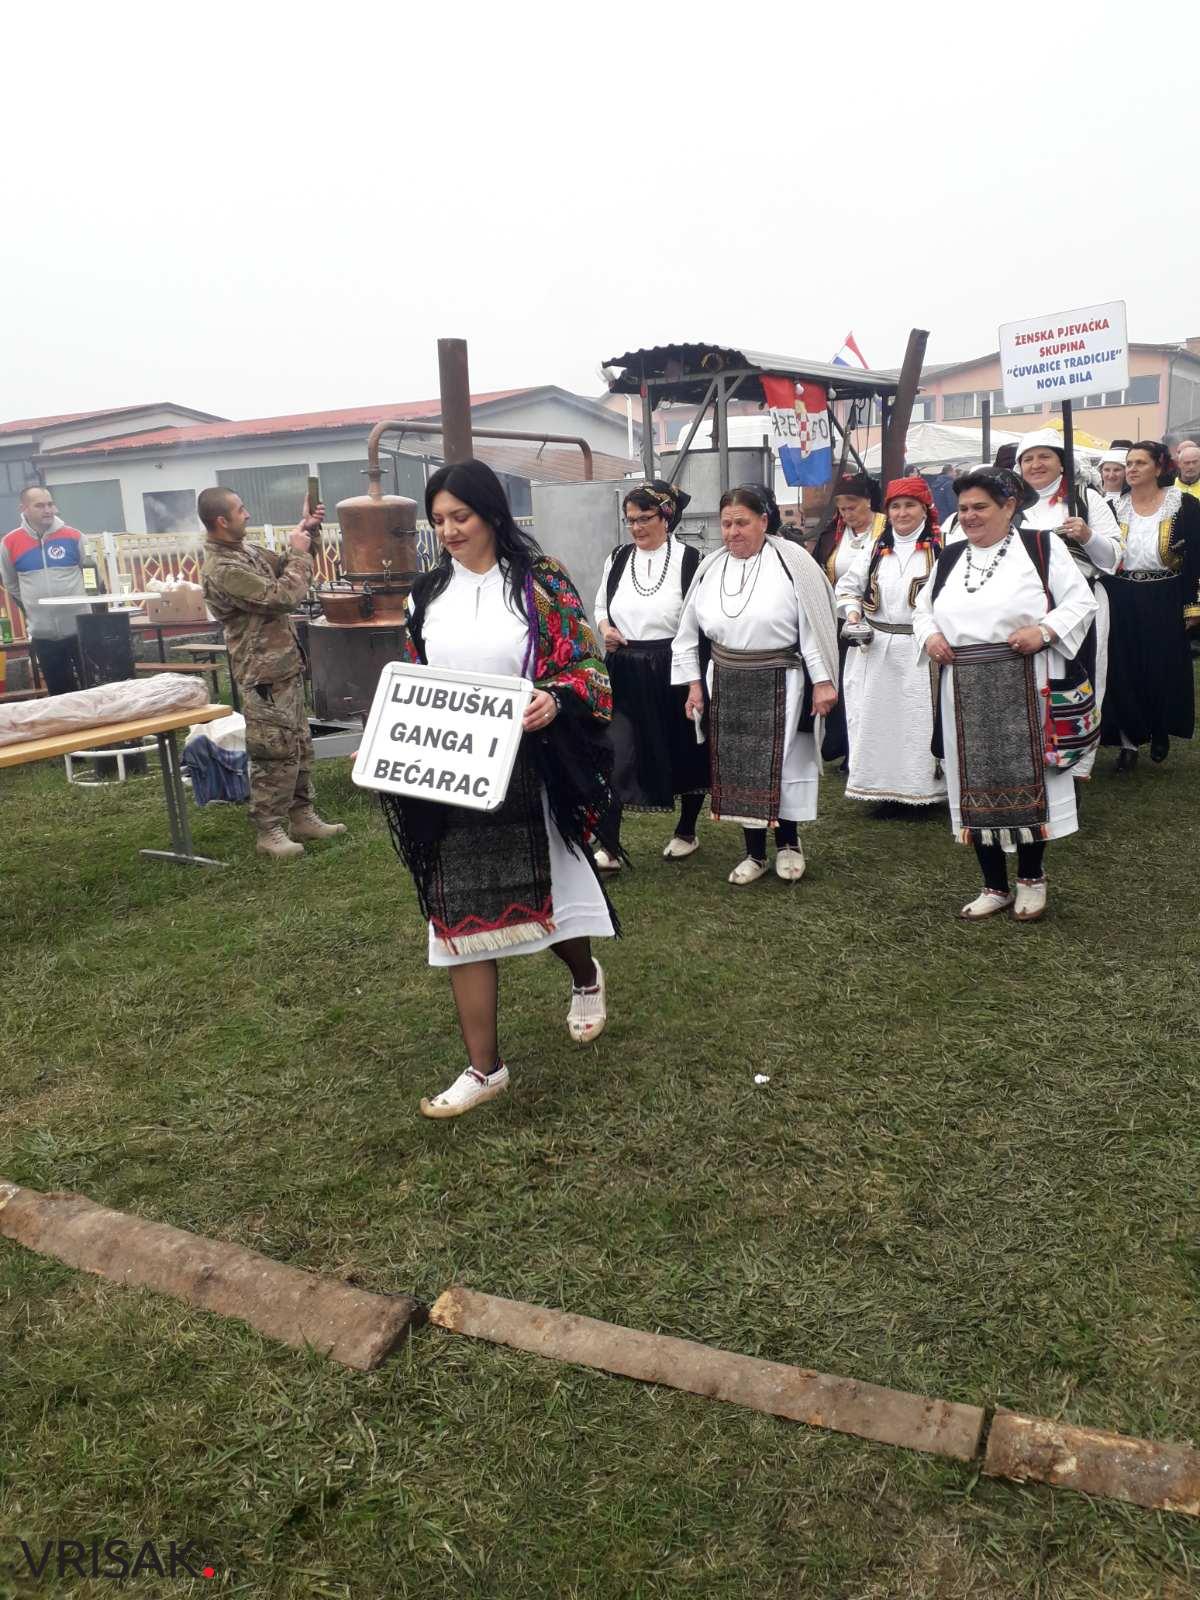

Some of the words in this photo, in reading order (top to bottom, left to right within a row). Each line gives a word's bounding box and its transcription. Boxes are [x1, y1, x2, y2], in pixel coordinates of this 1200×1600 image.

[1013, 330, 1054, 346] ŽENSKA
[1057, 317, 1110, 338] PJEVAČKA
[1039, 339, 1086, 358] SKUPINA
[1037, 375, 1066, 390] NOVA
[1069, 371, 1092, 384] BILA
[391, 683, 514, 720] LJUBUŠKA
[390, 722, 474, 754] GANGA
[488, 737, 499, 758] I
[374, 759, 491, 798] BEĆARAC
